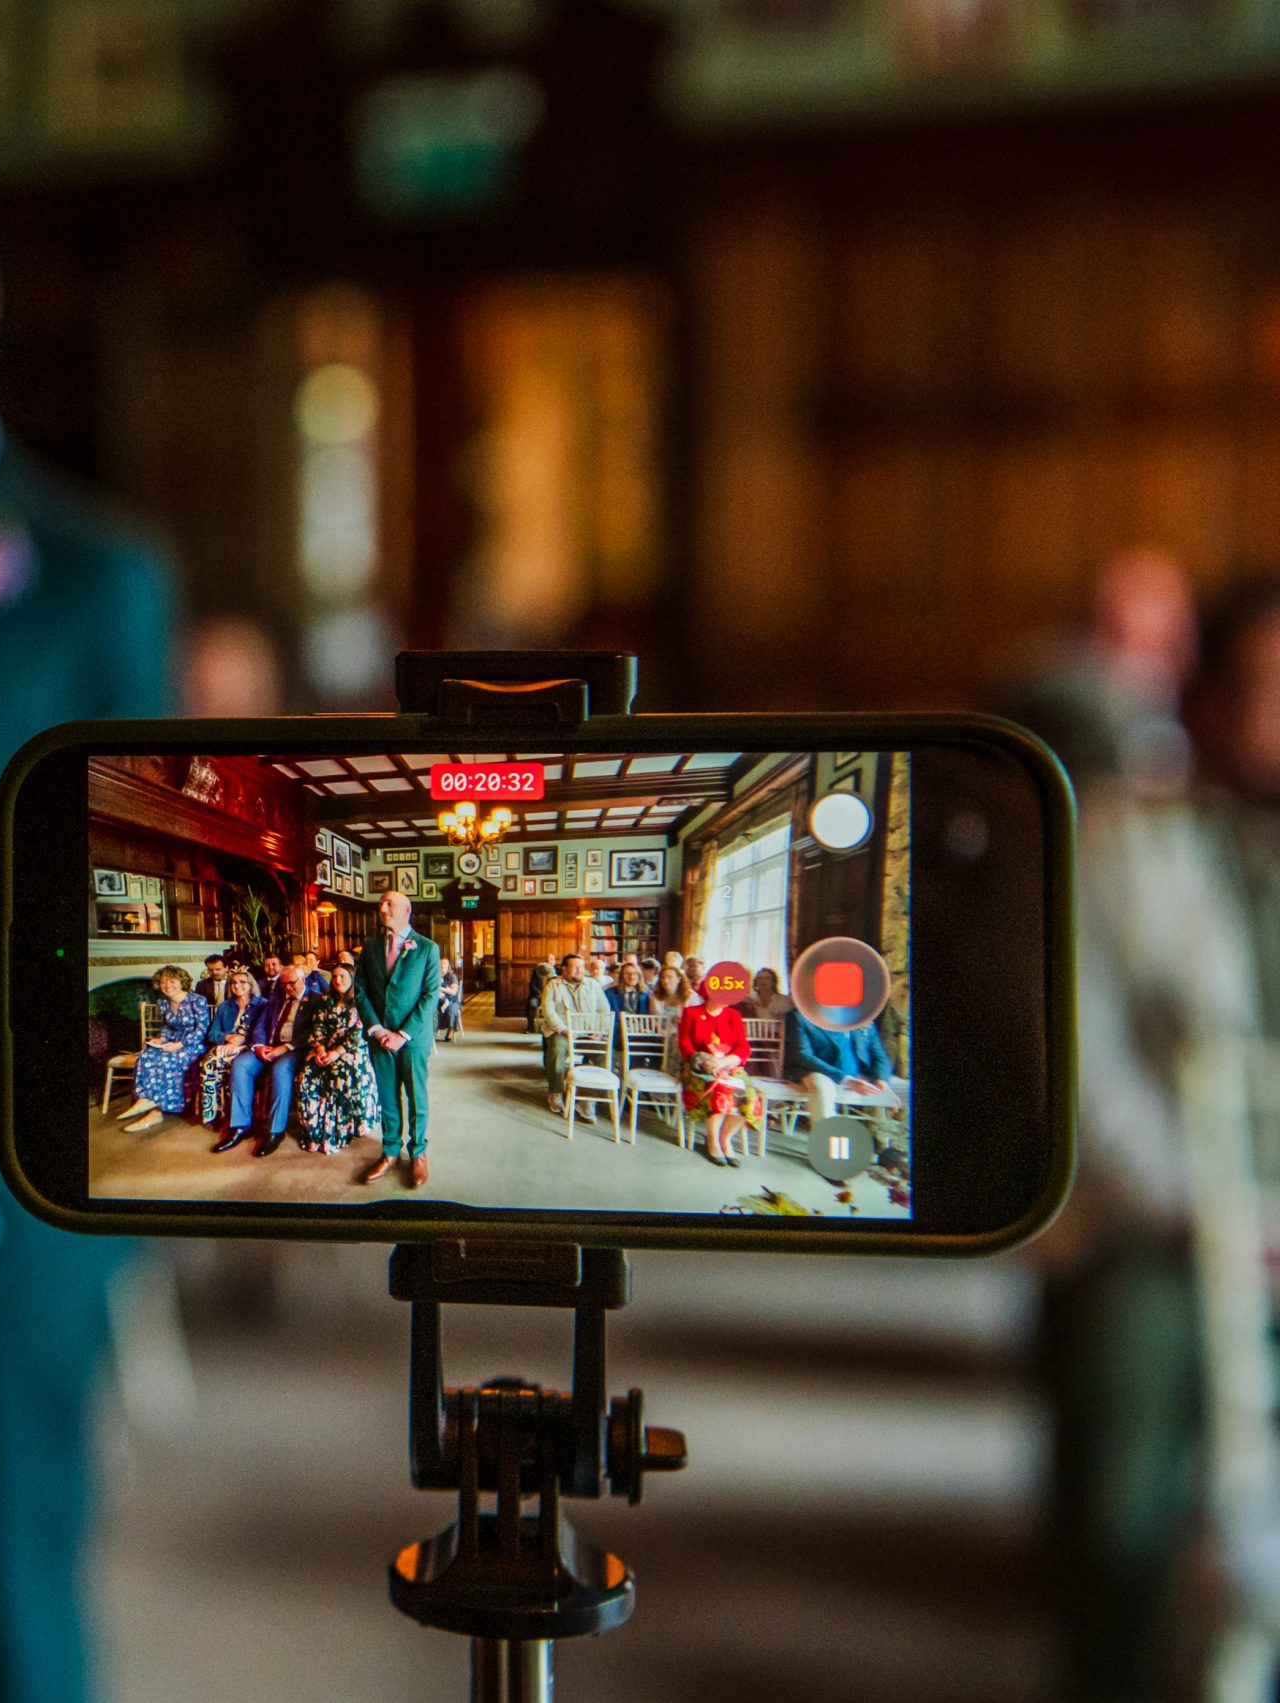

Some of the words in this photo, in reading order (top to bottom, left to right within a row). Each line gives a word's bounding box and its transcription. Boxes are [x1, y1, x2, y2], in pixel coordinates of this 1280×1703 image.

[441, 773, 534, 791] 00:20:32
[723, 885, 732, 898] 2
[709, 976, 745, 990] 0.5x
